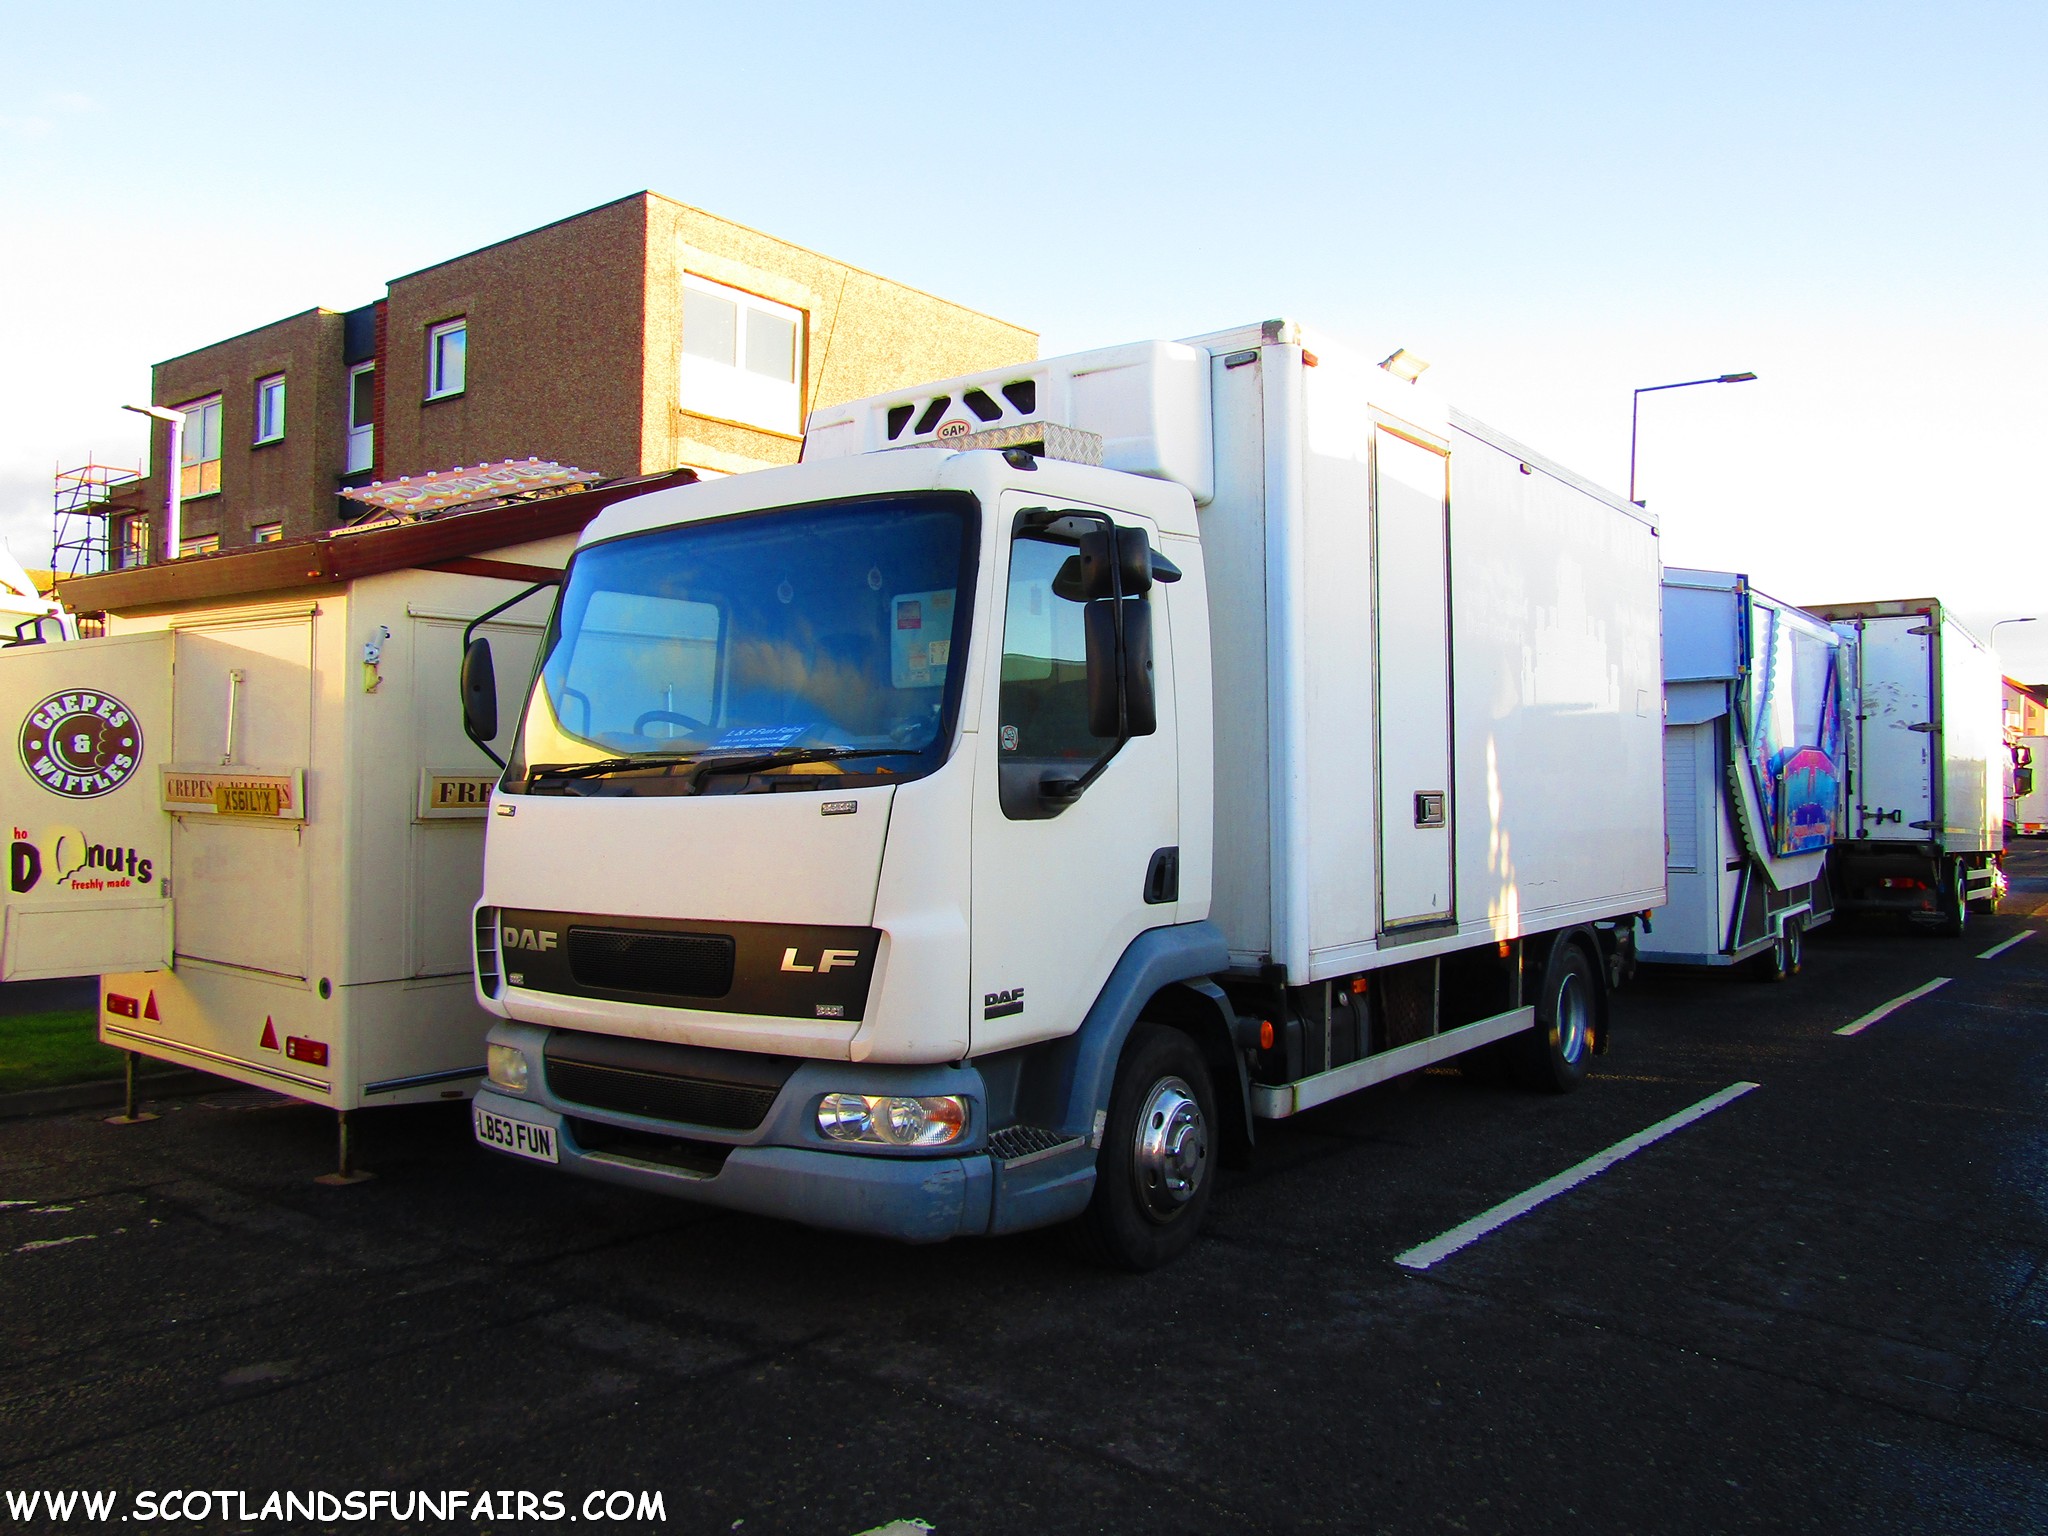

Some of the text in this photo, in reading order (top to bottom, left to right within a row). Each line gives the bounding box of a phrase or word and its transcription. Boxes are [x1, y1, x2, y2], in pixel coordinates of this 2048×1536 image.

[942, 424, 965, 437] GAH
[33, 694, 130, 731] CREPES
[73, 734, 91, 753] &
[32, 753, 133, 793] WAFFLES
[168, 778, 213, 798] CREPES
[13, 827, 28, 839] ho
[71, 877, 131, 892] freshly made
[503, 927, 558, 952] DAF
[780, 947, 859, 974] LF
[984, 987, 1025, 1006] DAF
[479, 1112, 551, 1156] LB53 FUN
